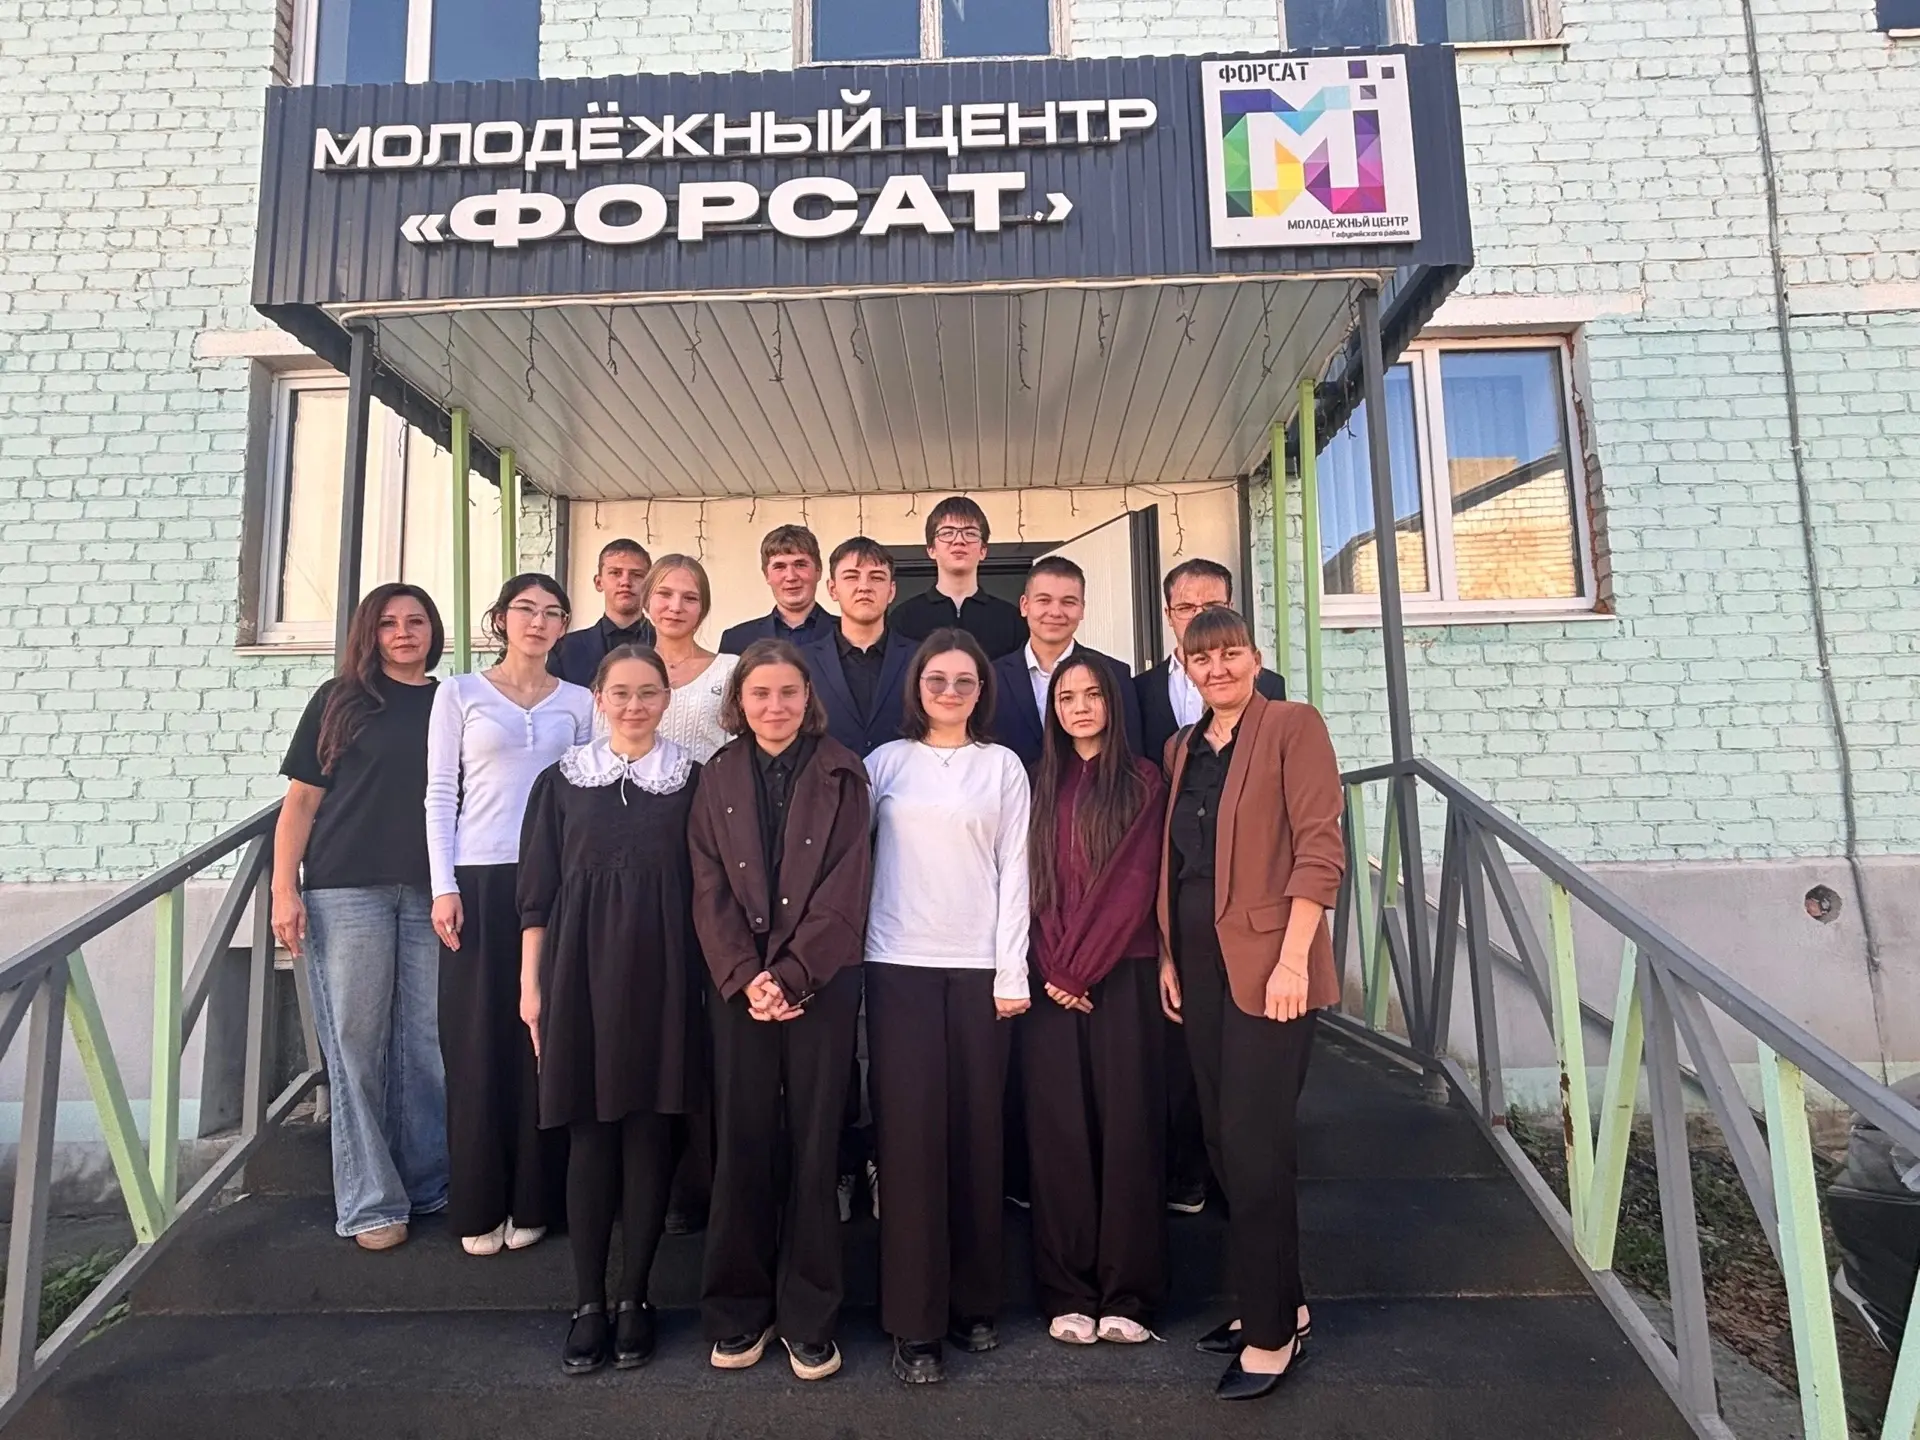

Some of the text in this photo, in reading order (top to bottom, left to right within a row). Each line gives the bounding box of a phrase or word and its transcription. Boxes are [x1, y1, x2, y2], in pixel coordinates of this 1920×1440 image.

[1218, 62, 1309, 83] ФОРСАТ
[313, 88, 1158, 172] МОЛОДЁЖНЫЙ ЦЕНТР
[1371, 216, 1409, 229] ЦЕНТР
[1384, 229, 1410, 238] района
